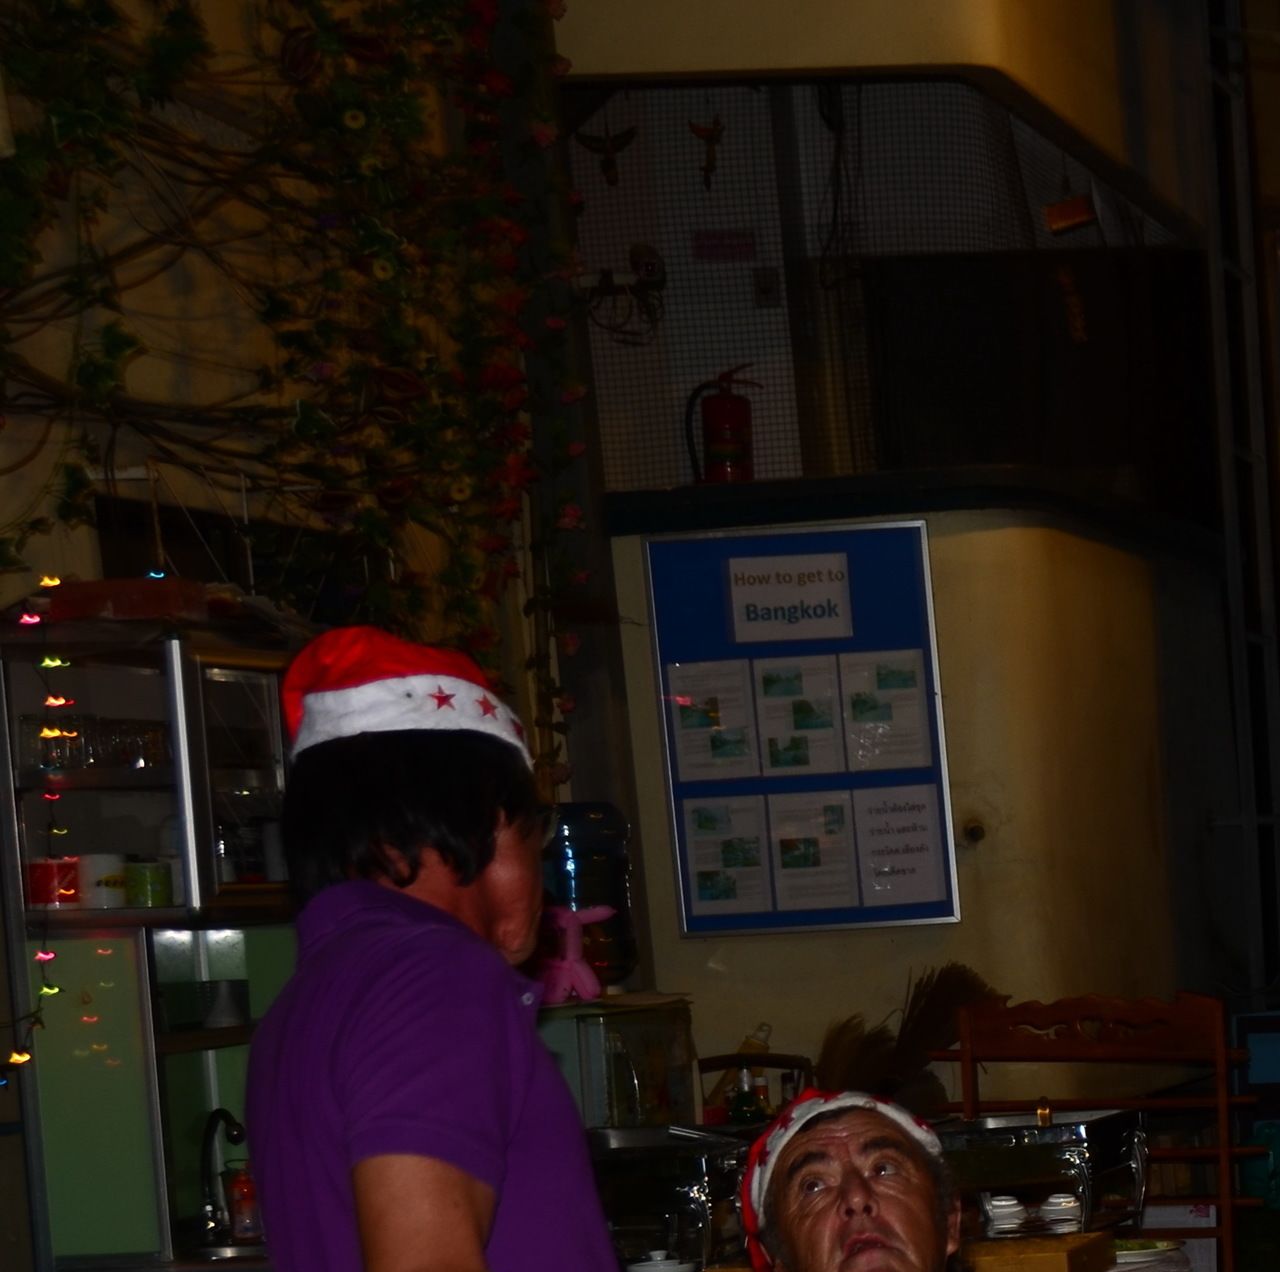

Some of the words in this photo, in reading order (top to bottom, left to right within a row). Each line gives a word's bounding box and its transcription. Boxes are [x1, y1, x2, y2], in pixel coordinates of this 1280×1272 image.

[733, 571, 771, 586] How
[775, 570, 793, 585] to
[797, 569, 824, 586] get
[827, 568, 846, 583] to
[744, 597, 840, 624] Bangkok
